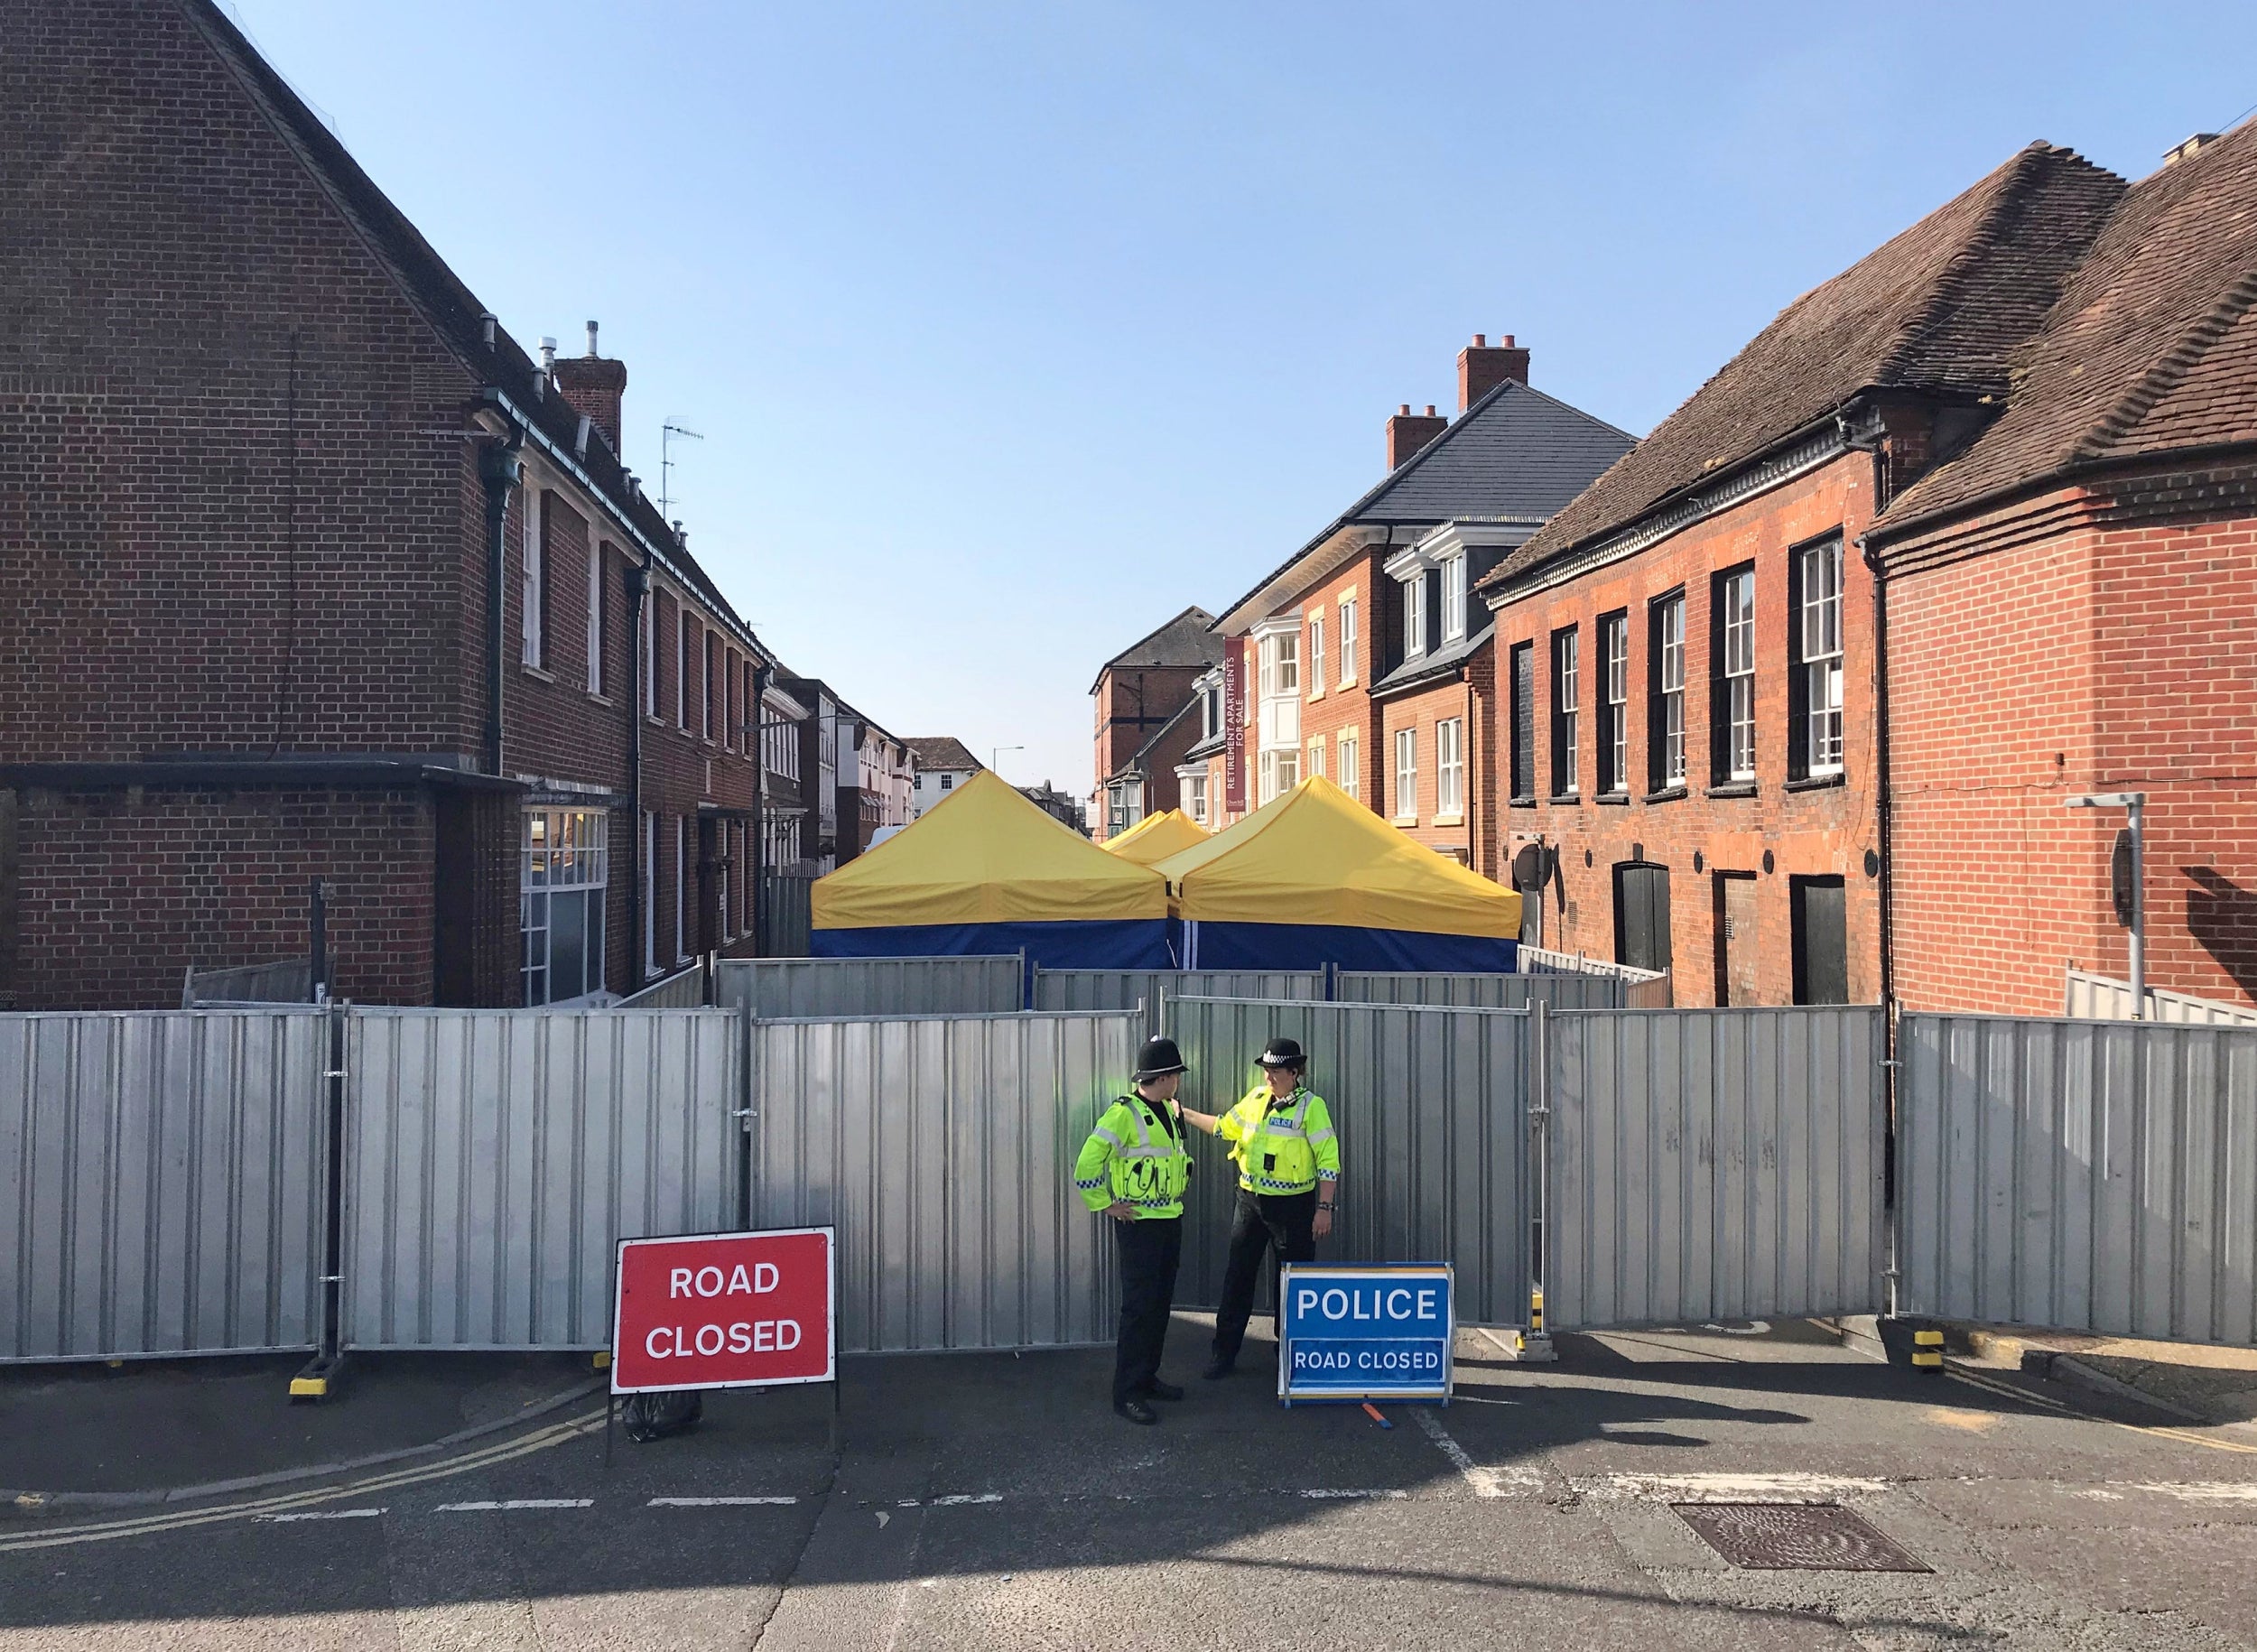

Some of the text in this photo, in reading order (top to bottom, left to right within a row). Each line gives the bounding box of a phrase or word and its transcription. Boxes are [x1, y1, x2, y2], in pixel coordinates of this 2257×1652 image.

[1226, 656, 1235, 789] RETIREMENT APARTMENTS
[1235, 699, 1243, 724] SALE
[670, 1262, 780, 1299] ROAD
[1297, 1288, 1436, 1321] POLICE
[646, 1319, 802, 1360] CLOSED
[1295, 1351, 1438, 1369] ROAD CLOSED
